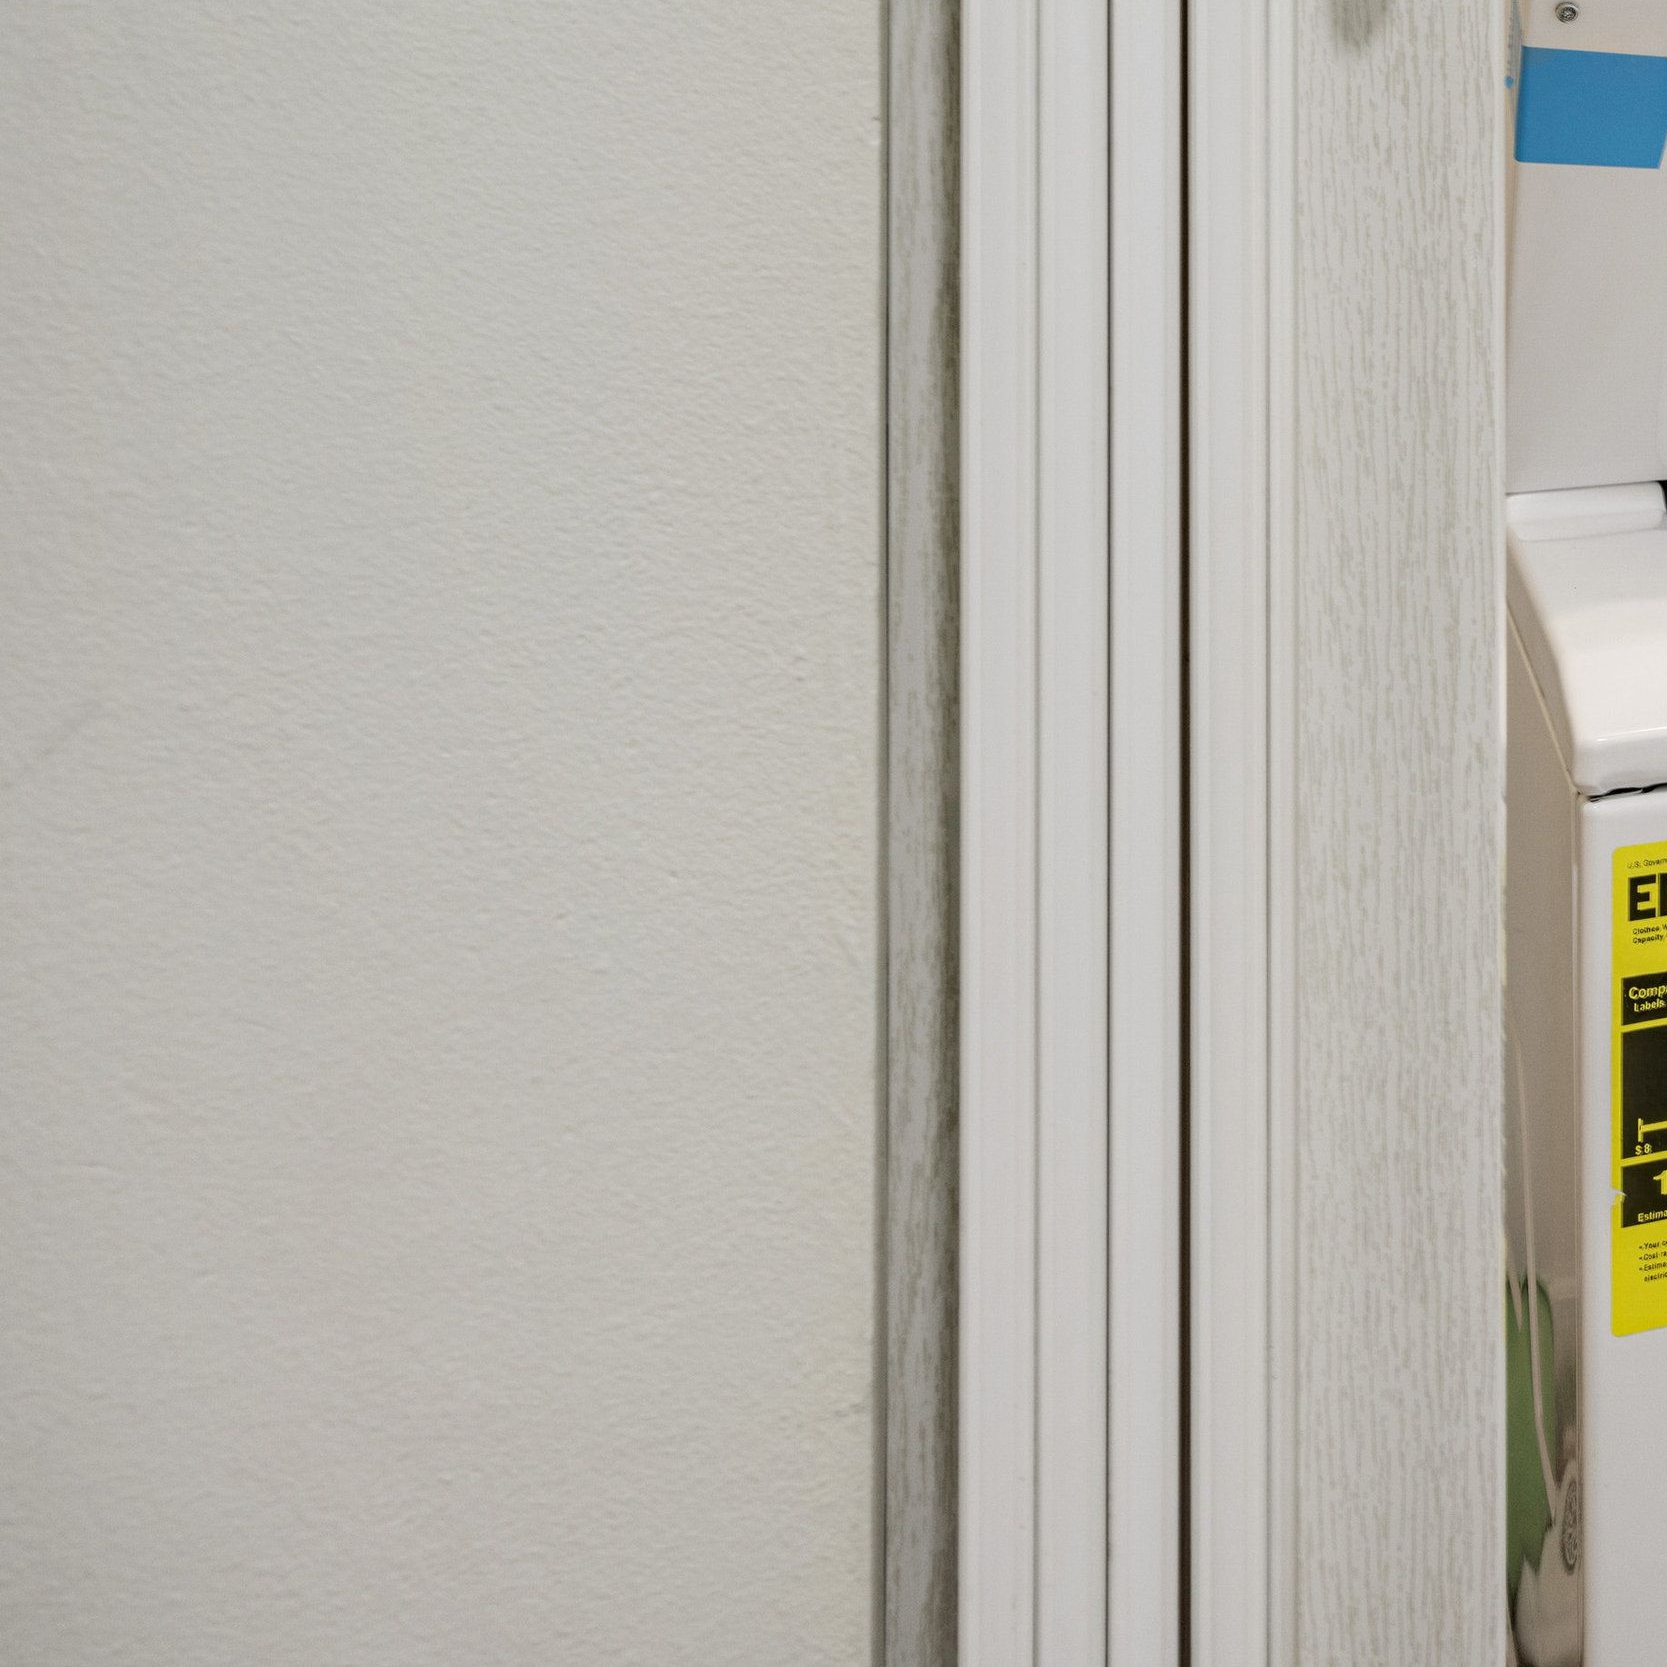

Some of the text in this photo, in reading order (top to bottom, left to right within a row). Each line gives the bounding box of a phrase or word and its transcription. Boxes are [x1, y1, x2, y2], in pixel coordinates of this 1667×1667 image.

[1632, 924, 1658, 935] Clothes
[1632, 933, 1663, 945] Capacity
[1634, 998, 1664, 1012] Labels
[1644, 1239, 1659, 1250] Your
